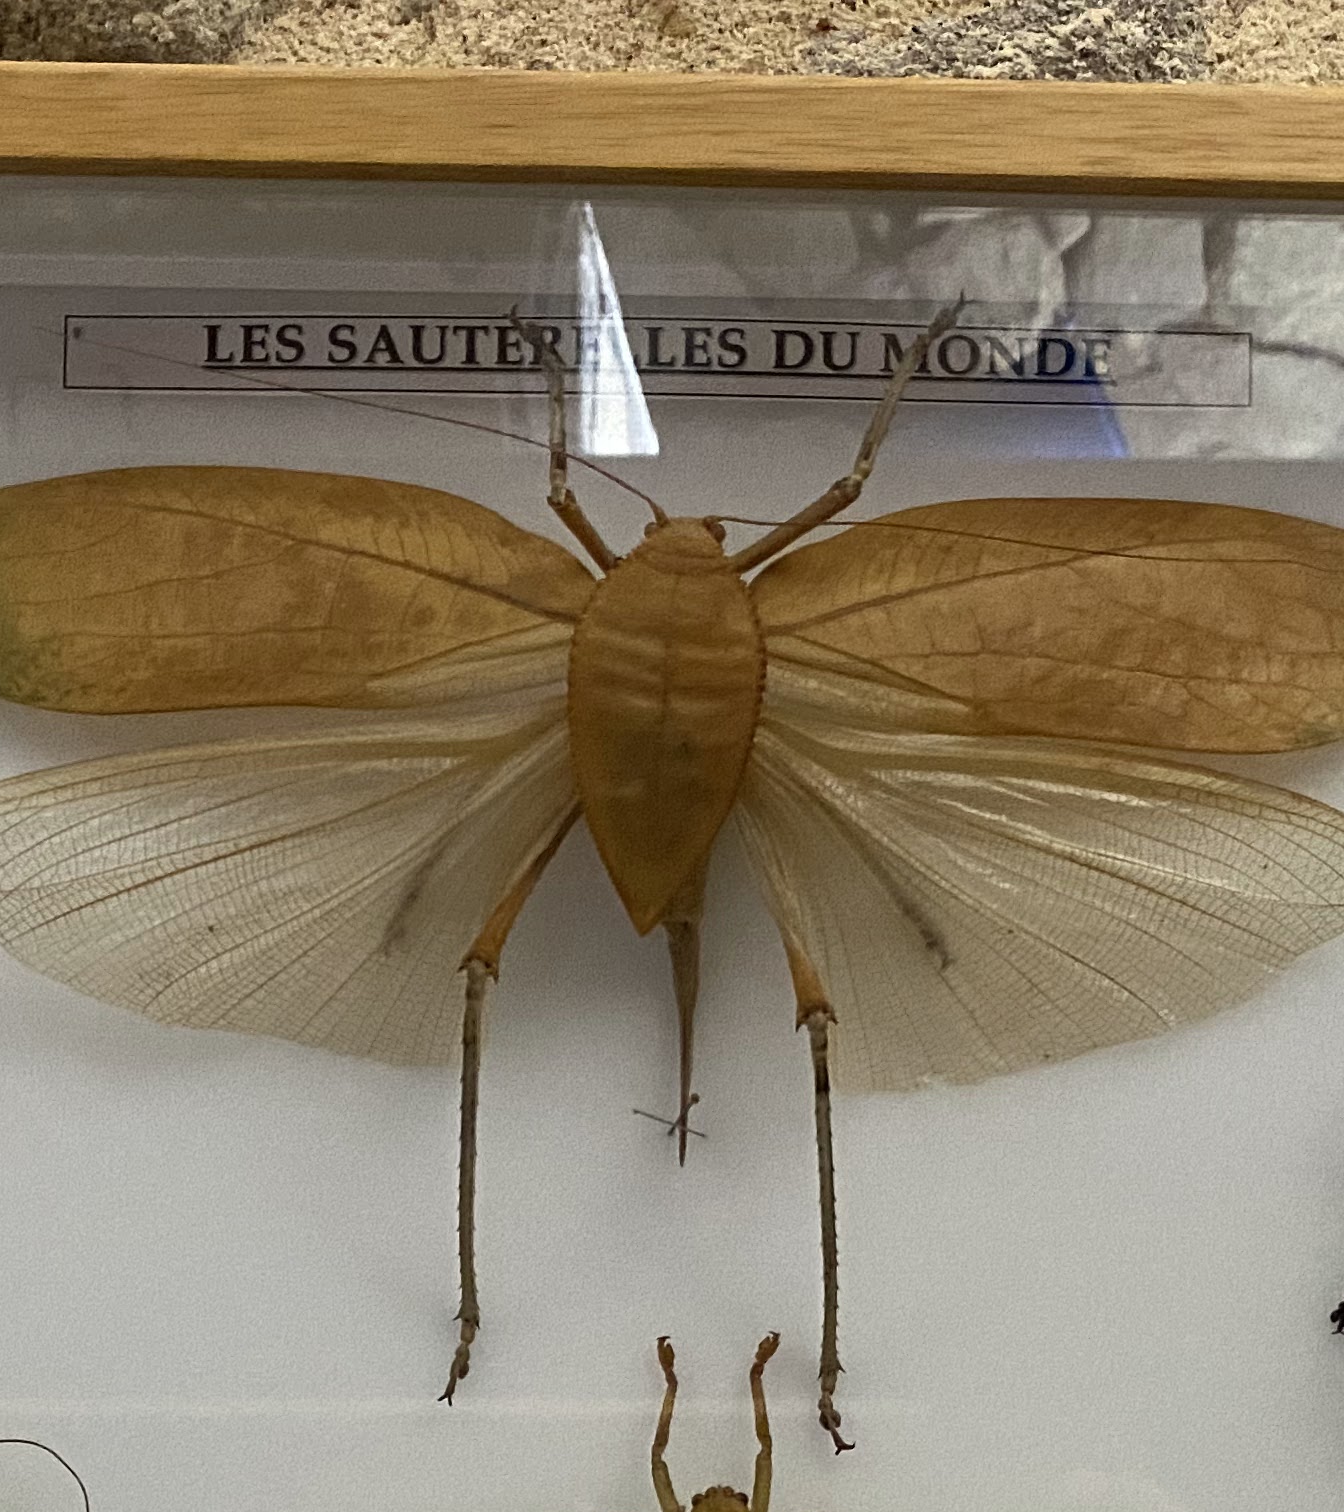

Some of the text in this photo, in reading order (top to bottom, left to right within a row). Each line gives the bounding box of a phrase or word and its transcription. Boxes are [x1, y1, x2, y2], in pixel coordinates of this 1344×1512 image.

[203, 324, 305, 366] LES
[771, 328, 860, 372] DU
[880, 332, 1115, 378] MONDE
